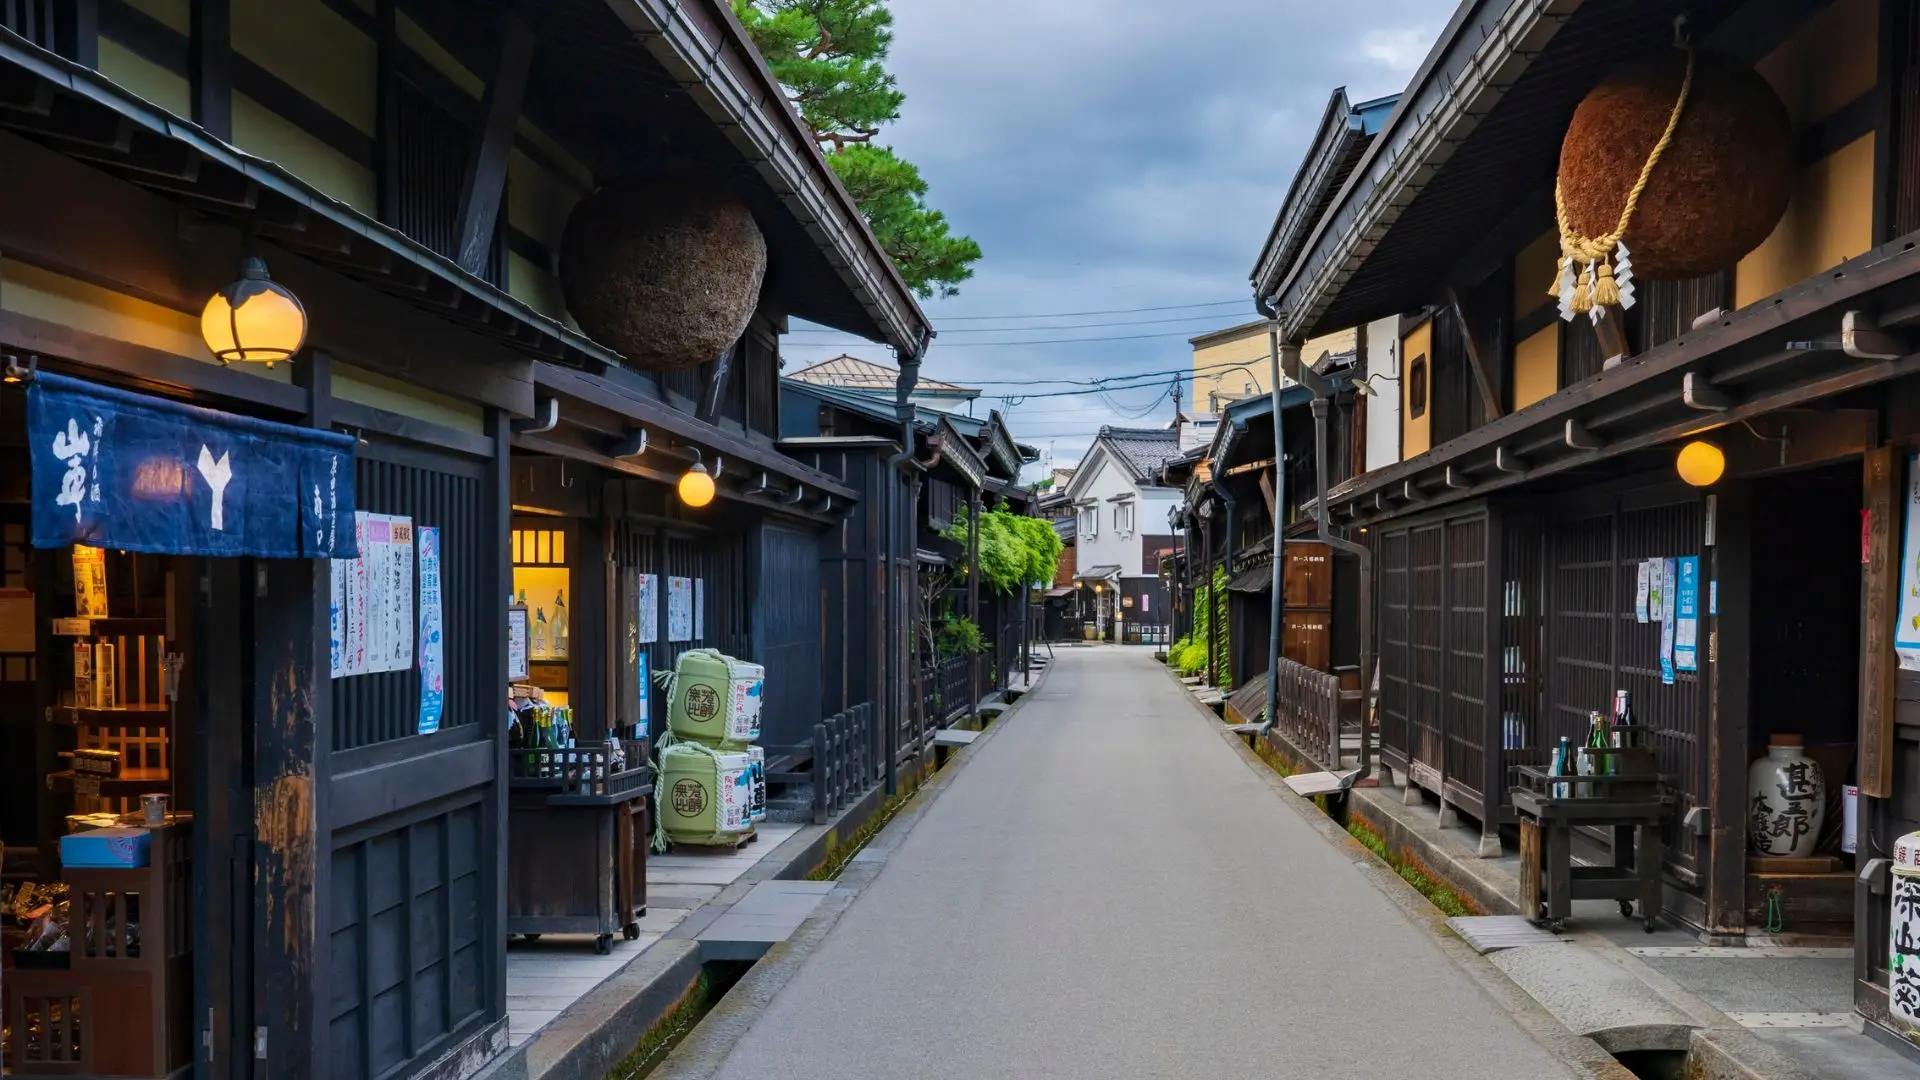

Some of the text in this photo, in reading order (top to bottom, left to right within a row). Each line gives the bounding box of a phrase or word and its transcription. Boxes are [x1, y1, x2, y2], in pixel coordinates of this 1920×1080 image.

[52, 417, 90, 524] 山車
[1771, 761, 1815, 851] 甚五郎
